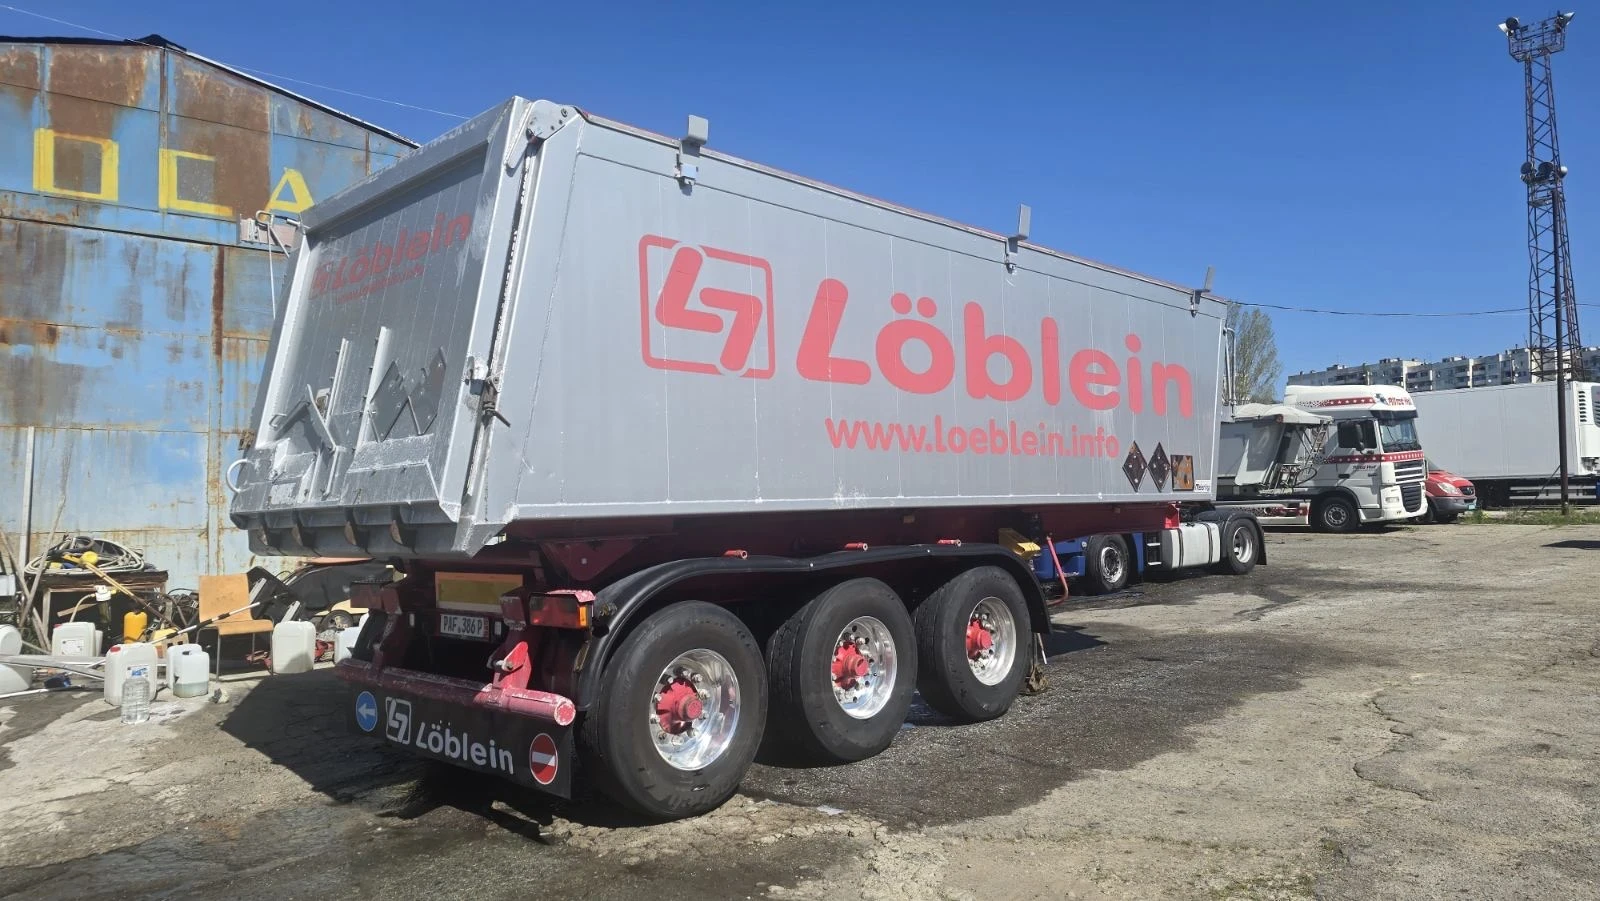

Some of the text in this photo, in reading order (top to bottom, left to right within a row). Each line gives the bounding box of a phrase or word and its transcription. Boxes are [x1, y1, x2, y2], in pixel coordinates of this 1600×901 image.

[332, 212, 473, 290] Löblein
[796, 278, 1194, 419] Löblein
[824, 414, 1120, 459] www.loeblein.info
[462, 617, 476, 634] 386
[415, 721, 515, 775] Löblein
